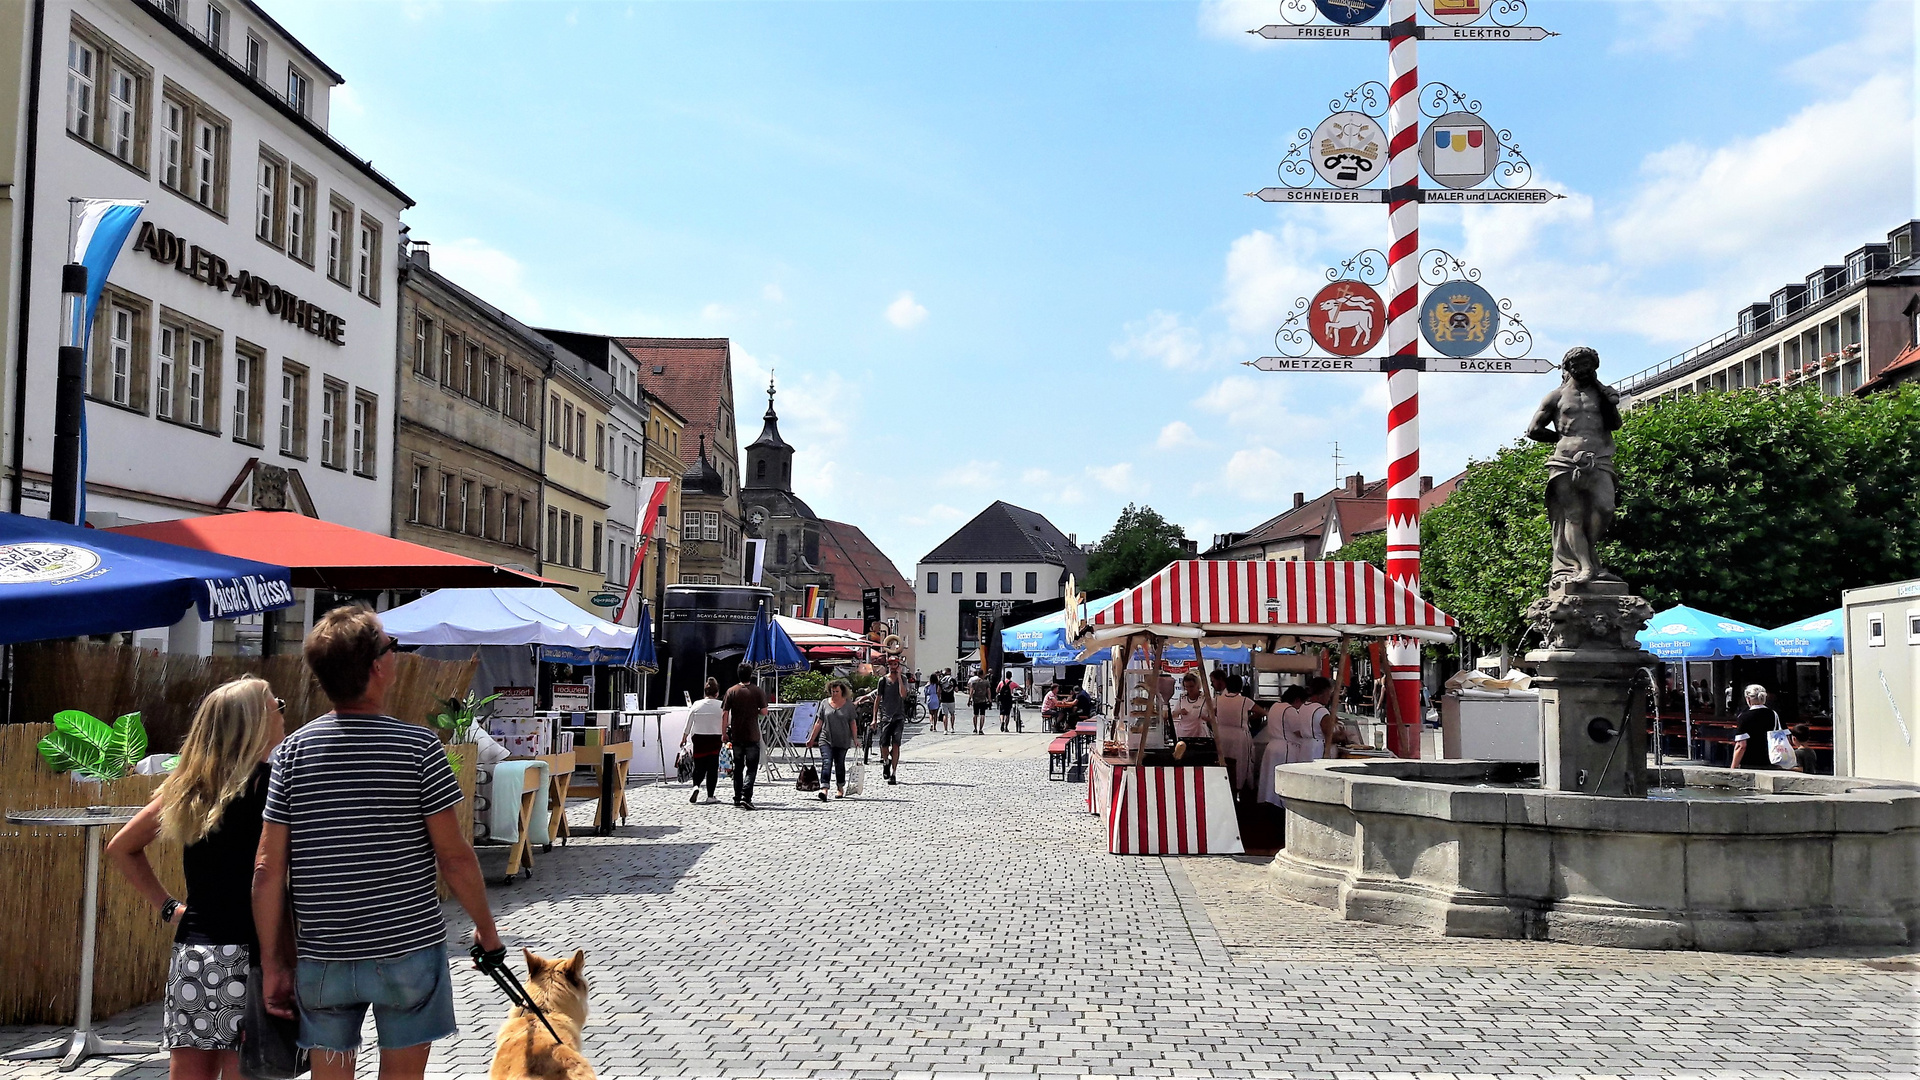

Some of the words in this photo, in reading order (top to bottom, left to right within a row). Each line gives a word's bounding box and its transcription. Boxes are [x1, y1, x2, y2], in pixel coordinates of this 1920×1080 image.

[1298, 28, 1350, 37] FRISEUR
[1453, 28, 1511, 38] ELEKTRO
[1287, 191, 1359, 200] SCHNEIDER
[1427, 192, 1464, 201] MALER
[1466, 192, 1485, 201] und
[1487, 192, 1547, 201] LACKIERER
[133, 221, 346, 347] ADLER-APOTHEKE
[1279, 360, 1353, 369] METZGER
[1460, 360, 1512, 370] BÄCKER
[205, 578, 250, 619] Maisel's
[242, 574, 292, 611] Weisse
[975, 601, 1015, 609] DEPOT
[1774, 638, 1793, 646] Becher
